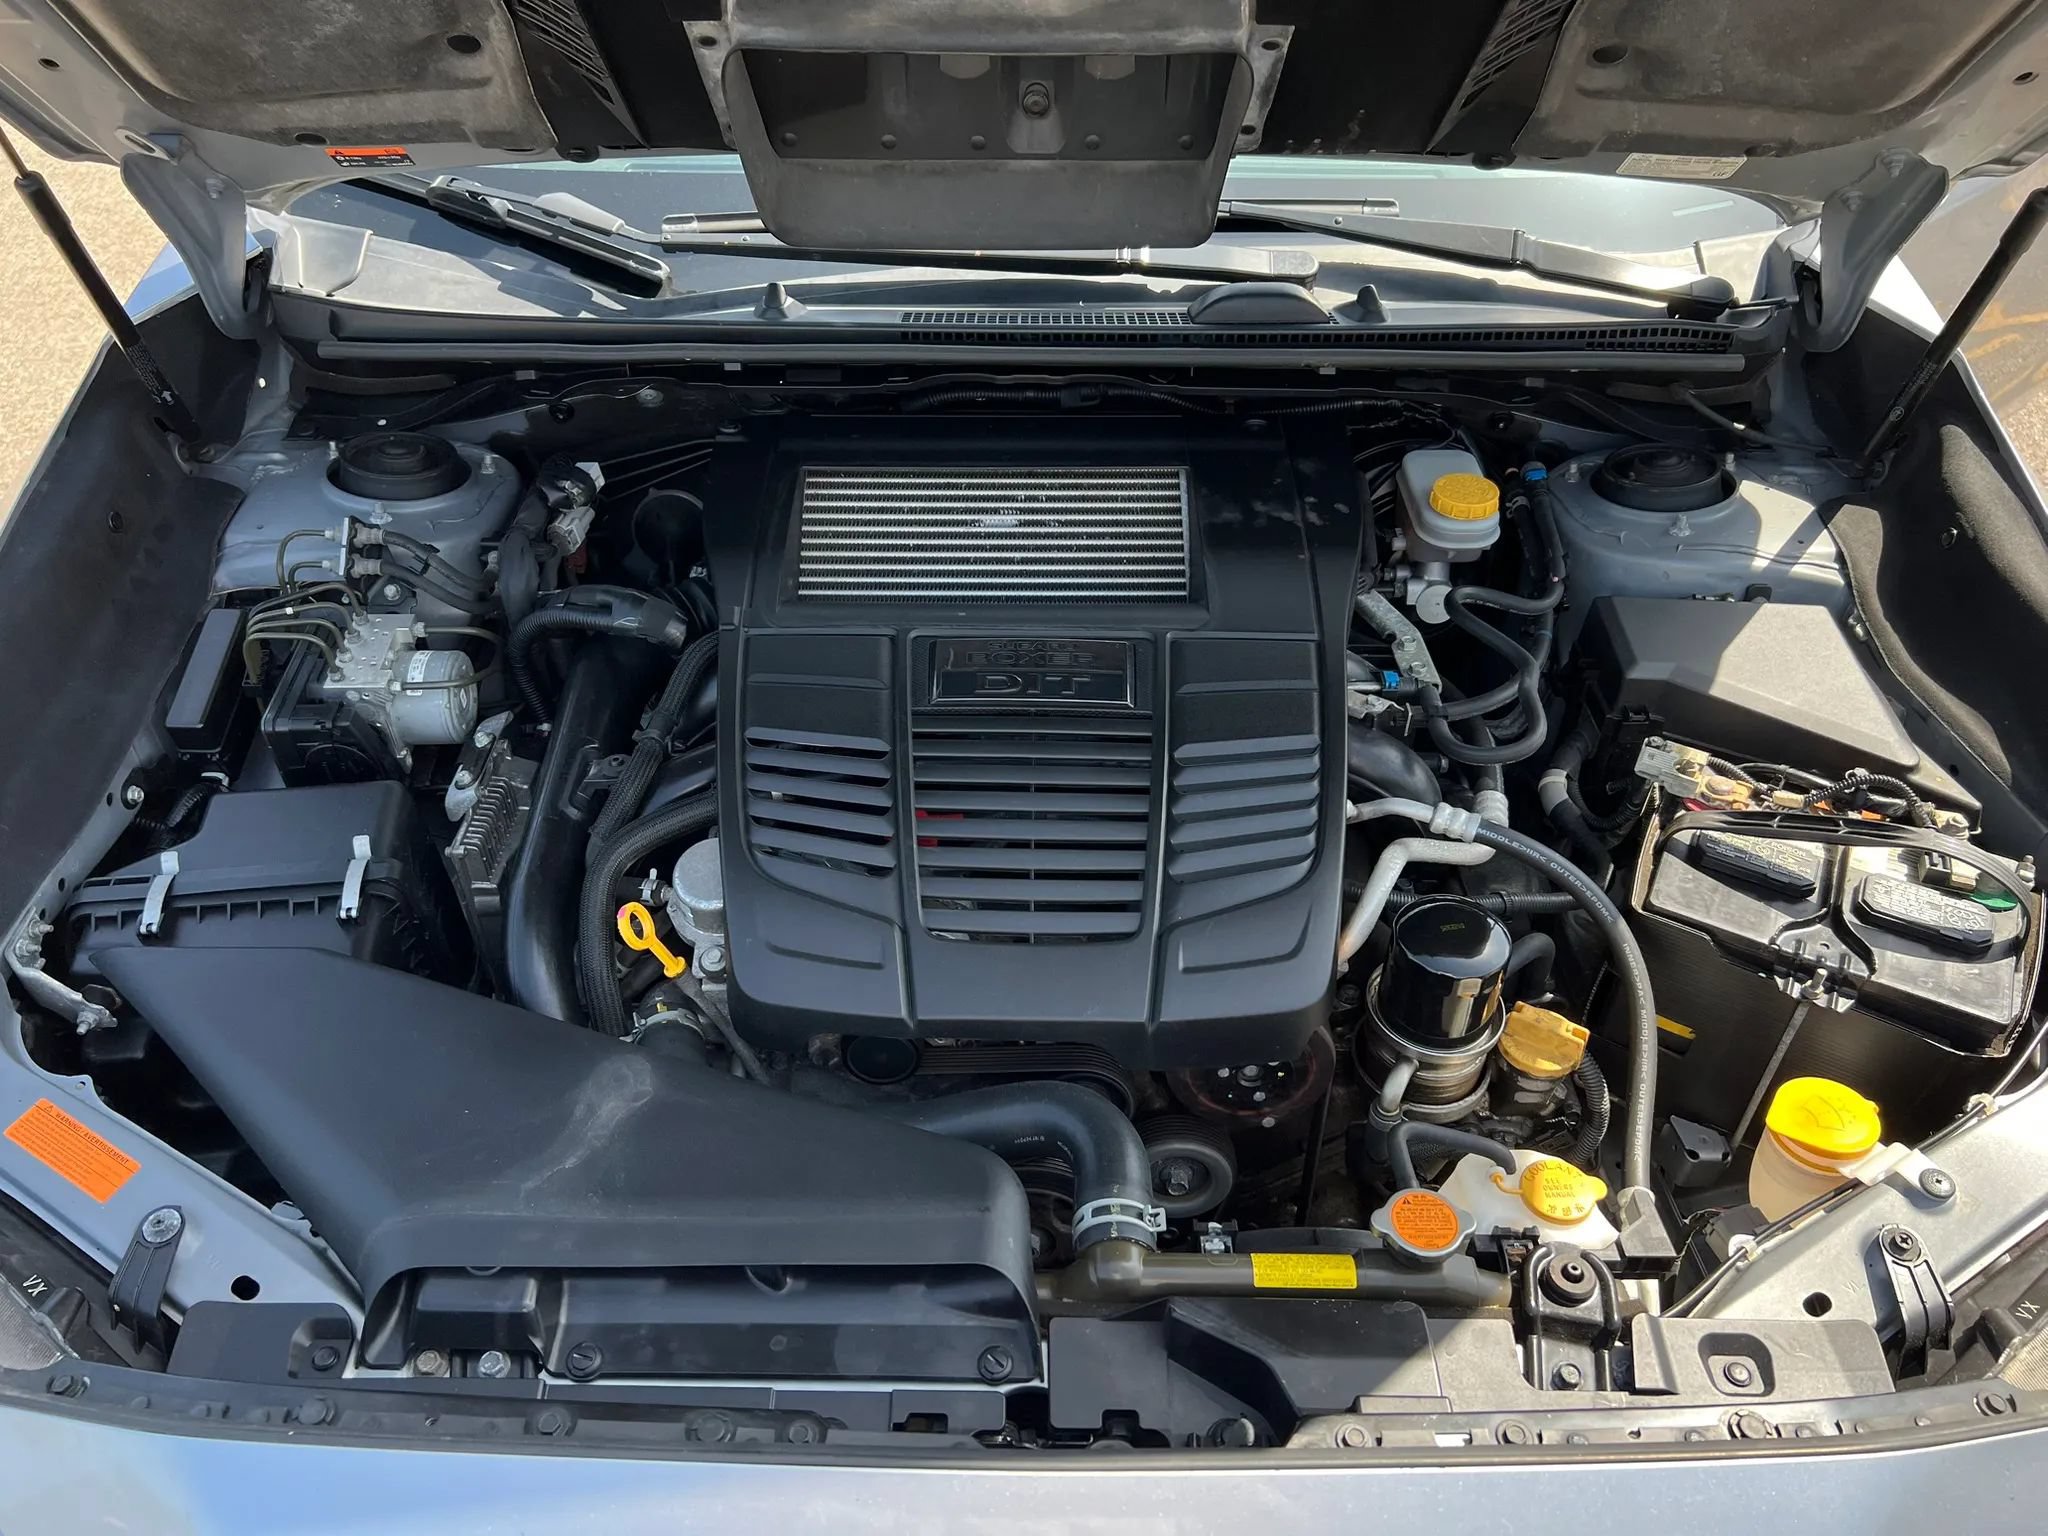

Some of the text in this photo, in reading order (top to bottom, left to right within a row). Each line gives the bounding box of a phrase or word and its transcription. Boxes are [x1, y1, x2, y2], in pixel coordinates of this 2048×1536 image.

[965, 652, 1096, 665] BOXER
[974, 673, 1091, 695] DIT
[55, 1113, 81, 1132] WARNING
[84, 1131, 130, 1165] AVERTISSEMENT
[1524, 1161, 1583, 1182] COOLANT
